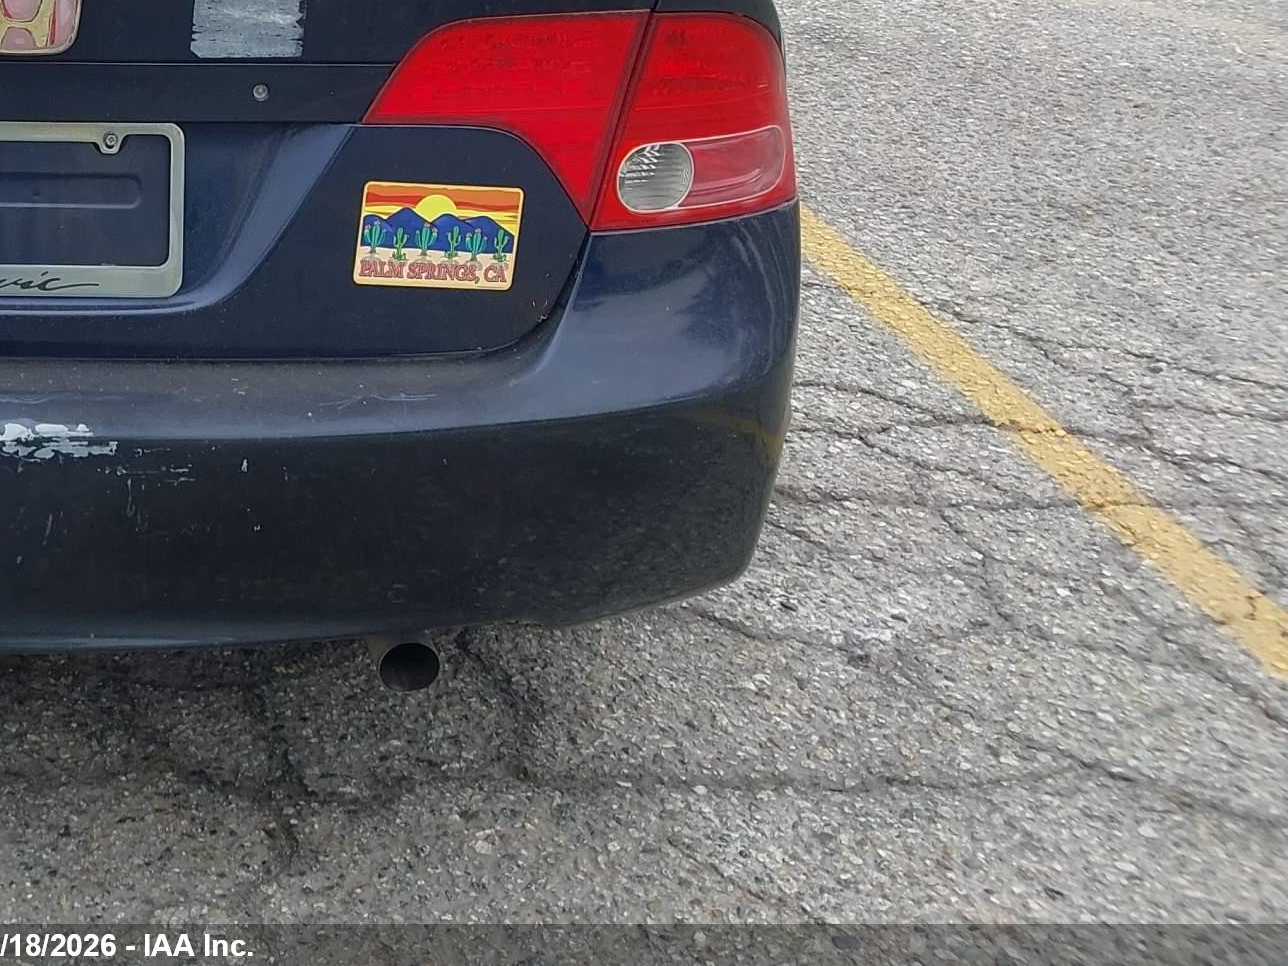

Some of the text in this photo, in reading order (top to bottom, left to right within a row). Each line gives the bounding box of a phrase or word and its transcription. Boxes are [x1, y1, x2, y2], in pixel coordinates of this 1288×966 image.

[358, 259, 508, 284] PALM SPRINGS, CA
